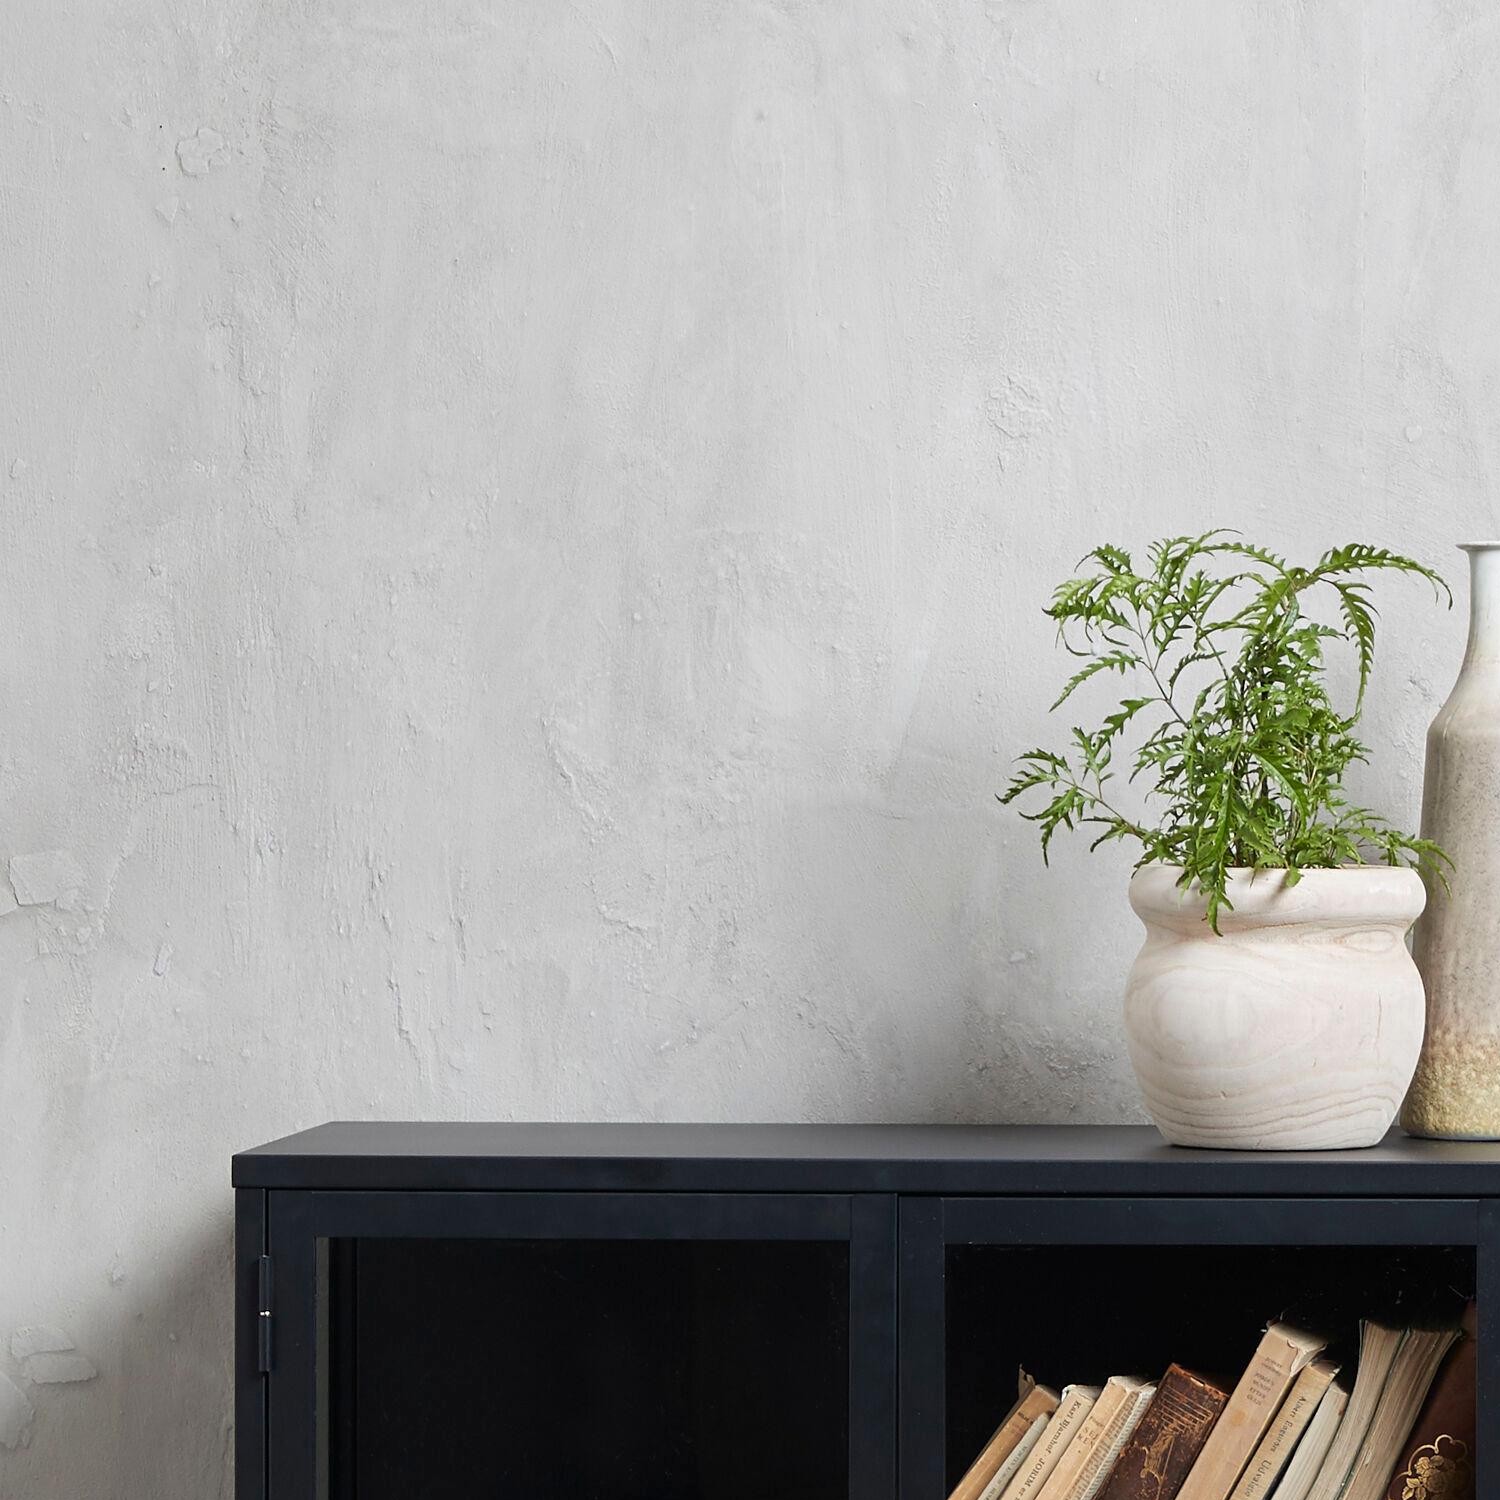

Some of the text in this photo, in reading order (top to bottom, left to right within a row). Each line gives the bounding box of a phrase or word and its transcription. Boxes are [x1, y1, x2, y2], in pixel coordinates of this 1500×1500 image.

[1066, 1399, 1082, 1419] Karl
[1042, 1417, 1070, 1453] Bjarnhof
[1017, 1487, 1026, 1496] er
